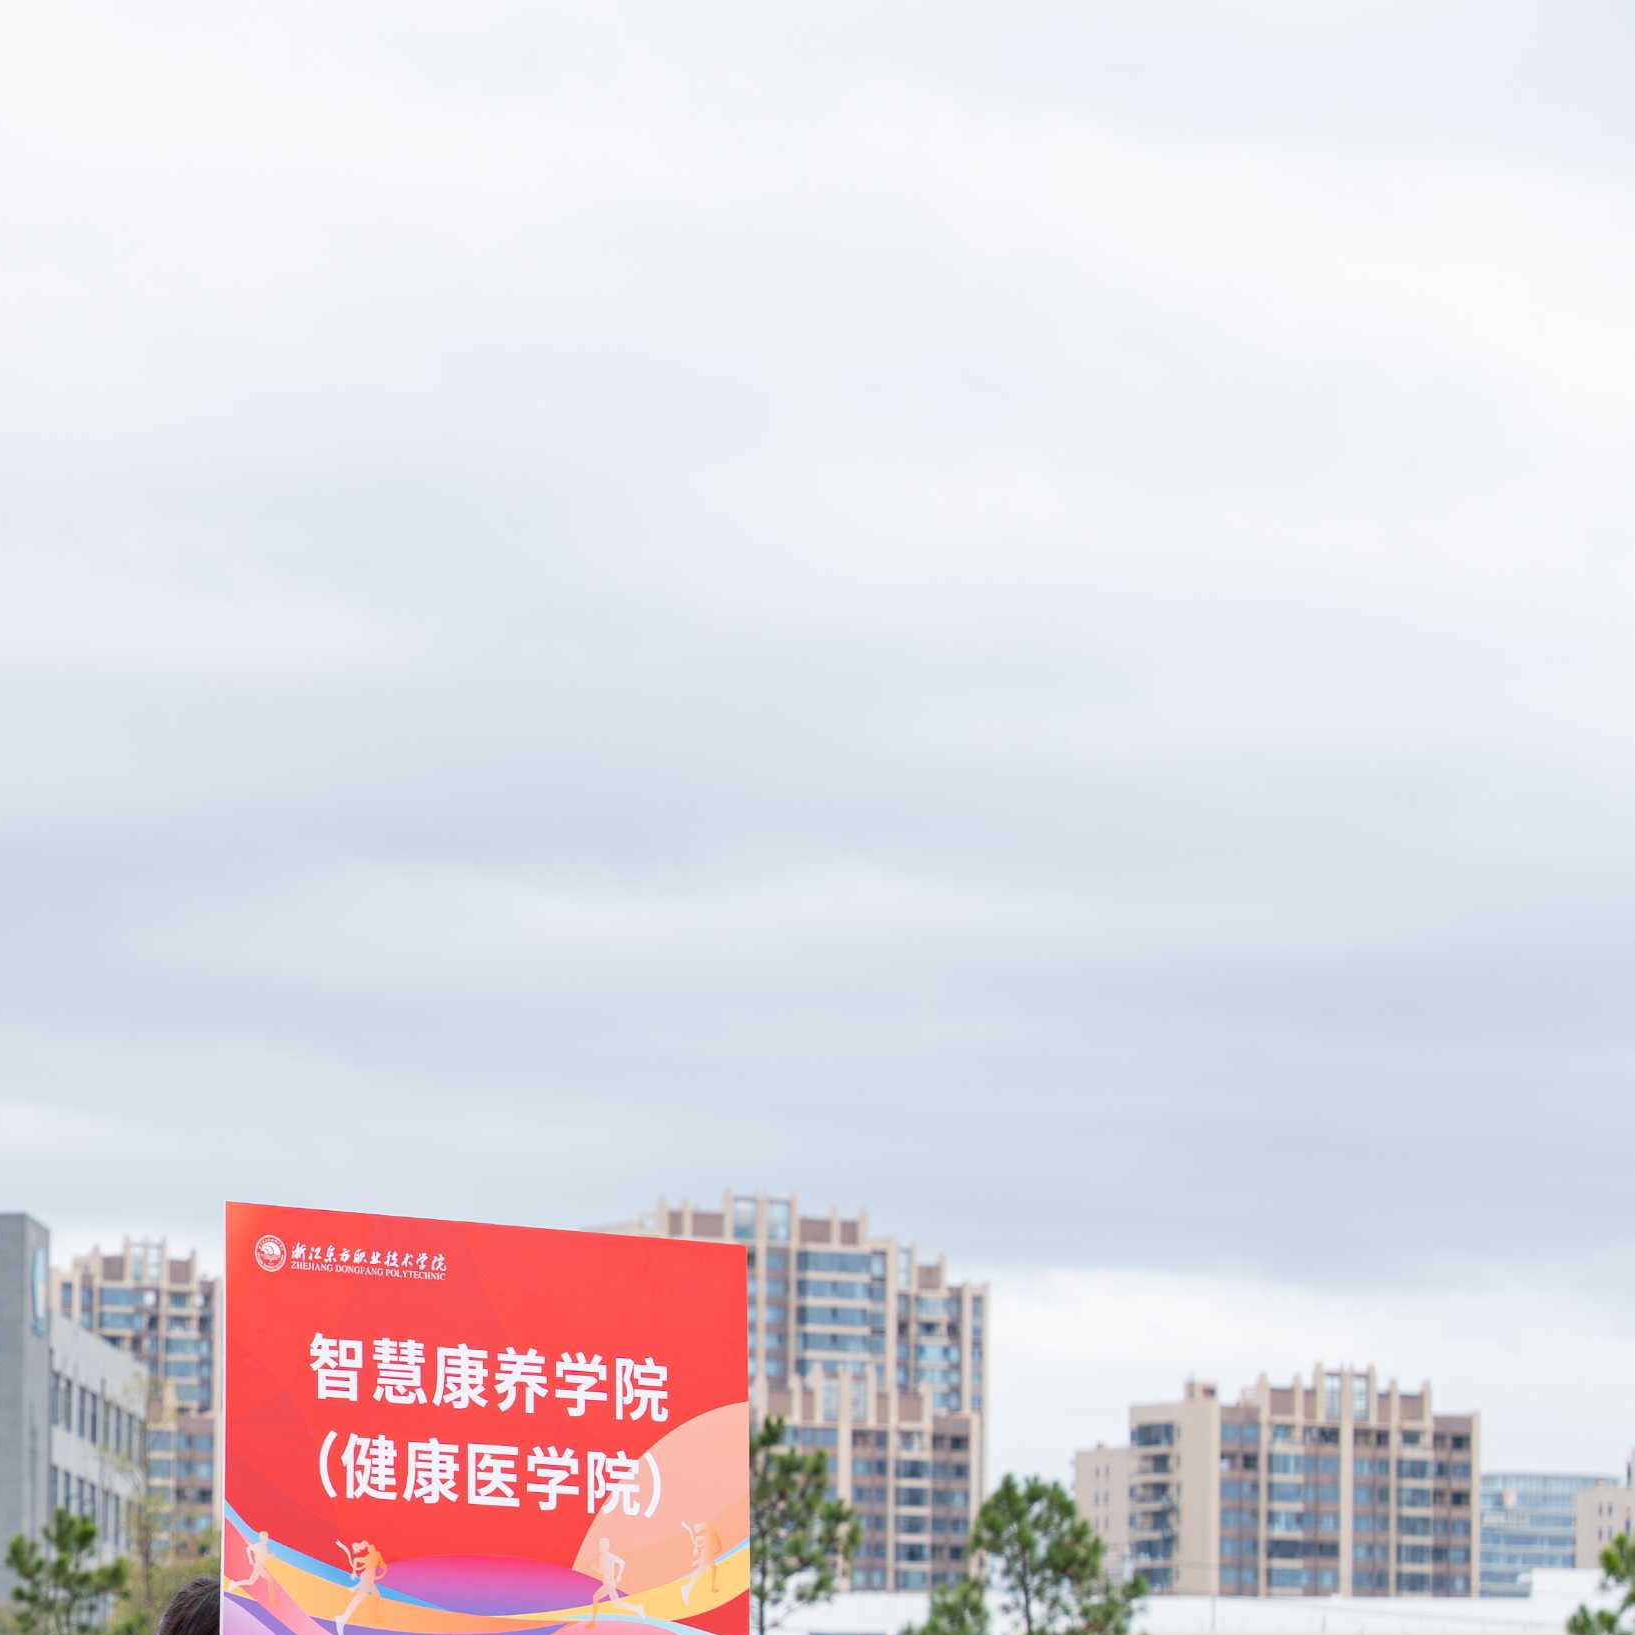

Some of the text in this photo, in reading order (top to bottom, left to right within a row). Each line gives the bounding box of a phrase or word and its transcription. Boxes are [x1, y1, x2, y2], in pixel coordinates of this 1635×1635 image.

[291, 1242, 448, 1272] 浙江东方职业技术学院
[291, 1260, 447, 1281] ZHEJIANG DONGFANG POLYTECHNIC
[308, 1331, 670, 1423] 智慧康养学院
[319, 1429, 663, 1519] （健康医学院）
